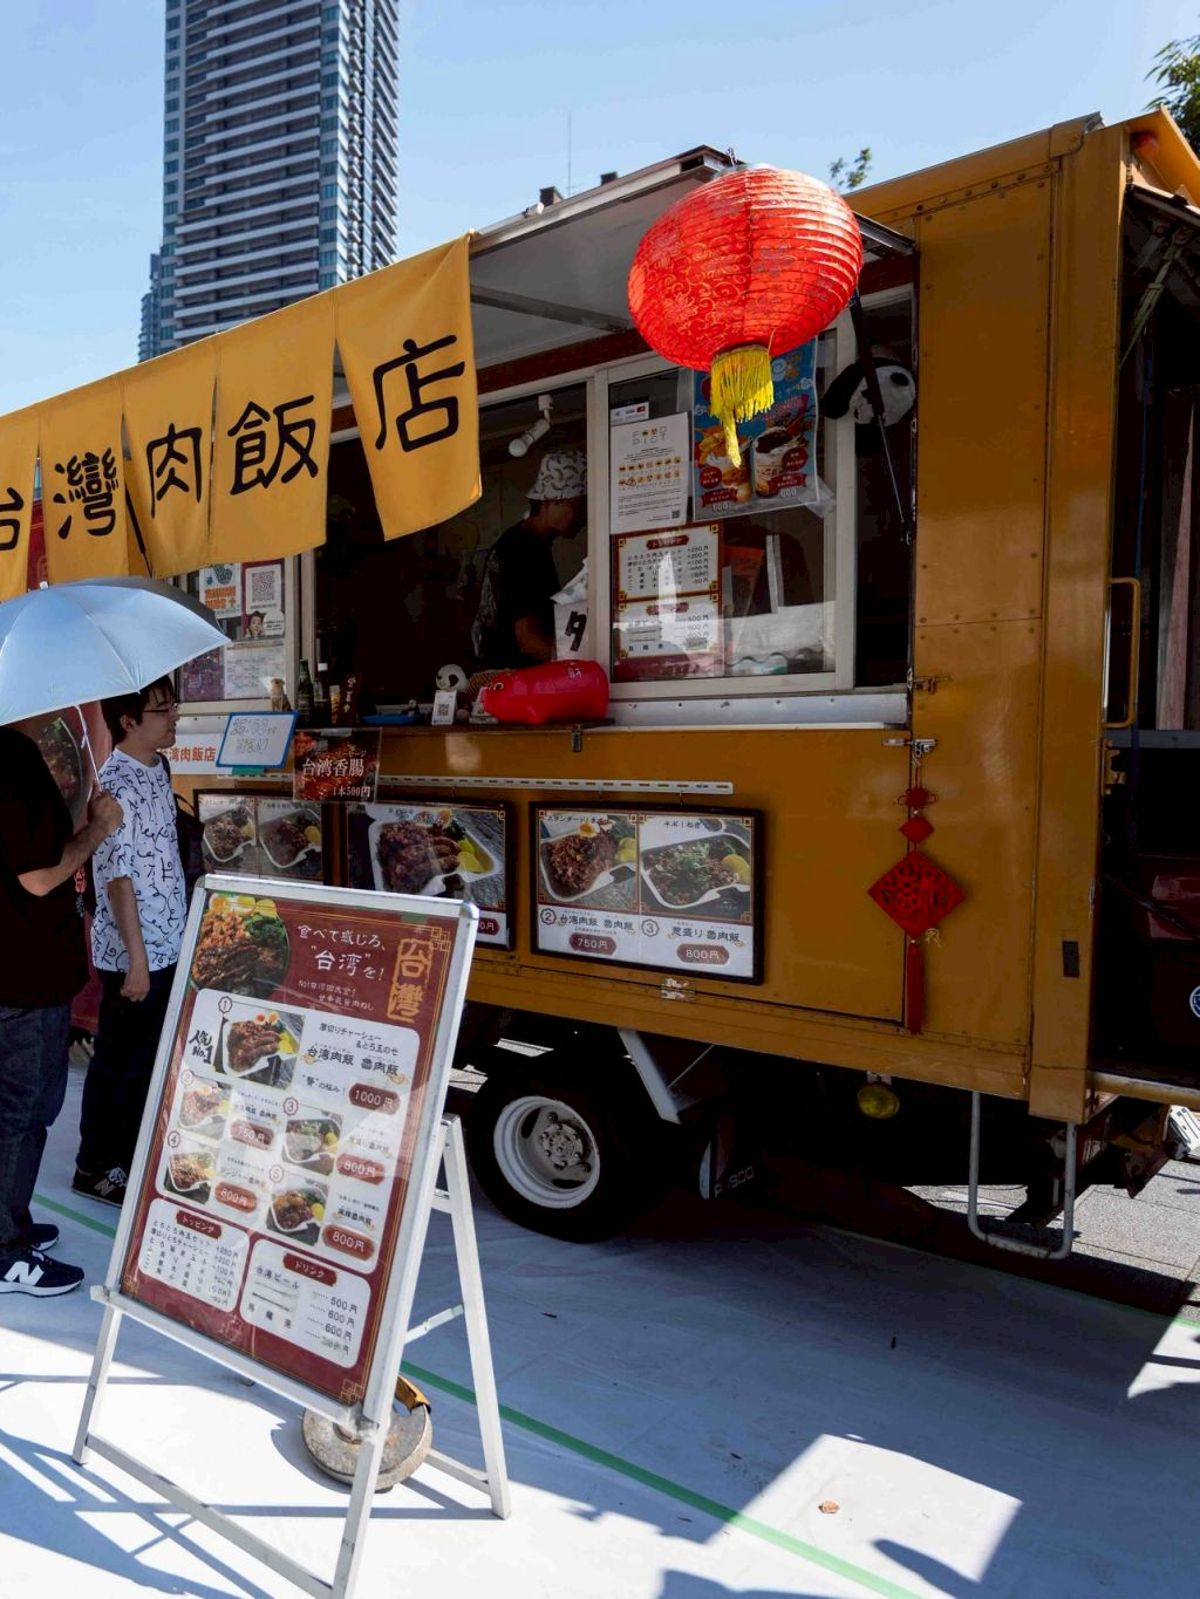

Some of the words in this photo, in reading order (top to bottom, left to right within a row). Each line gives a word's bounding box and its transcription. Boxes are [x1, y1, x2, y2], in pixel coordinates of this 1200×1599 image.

[161, 745, 216, 763] 湾肉飯店
[302, 757, 364, 778] 台湾香腸
[298, 924, 385, 951] 食べて感じろ、
[577, 937, 608, 950] 750円
[686, 948, 720, 960] 800円
[355, 1089, 394, 1113] 1000円
[344, 1160, 376, 1178] 800円
[333, 1231, 364, 1253] 800円
[4, 1261, 45, 1286] N
[295, 1260, 325, 1278] ドリンク
